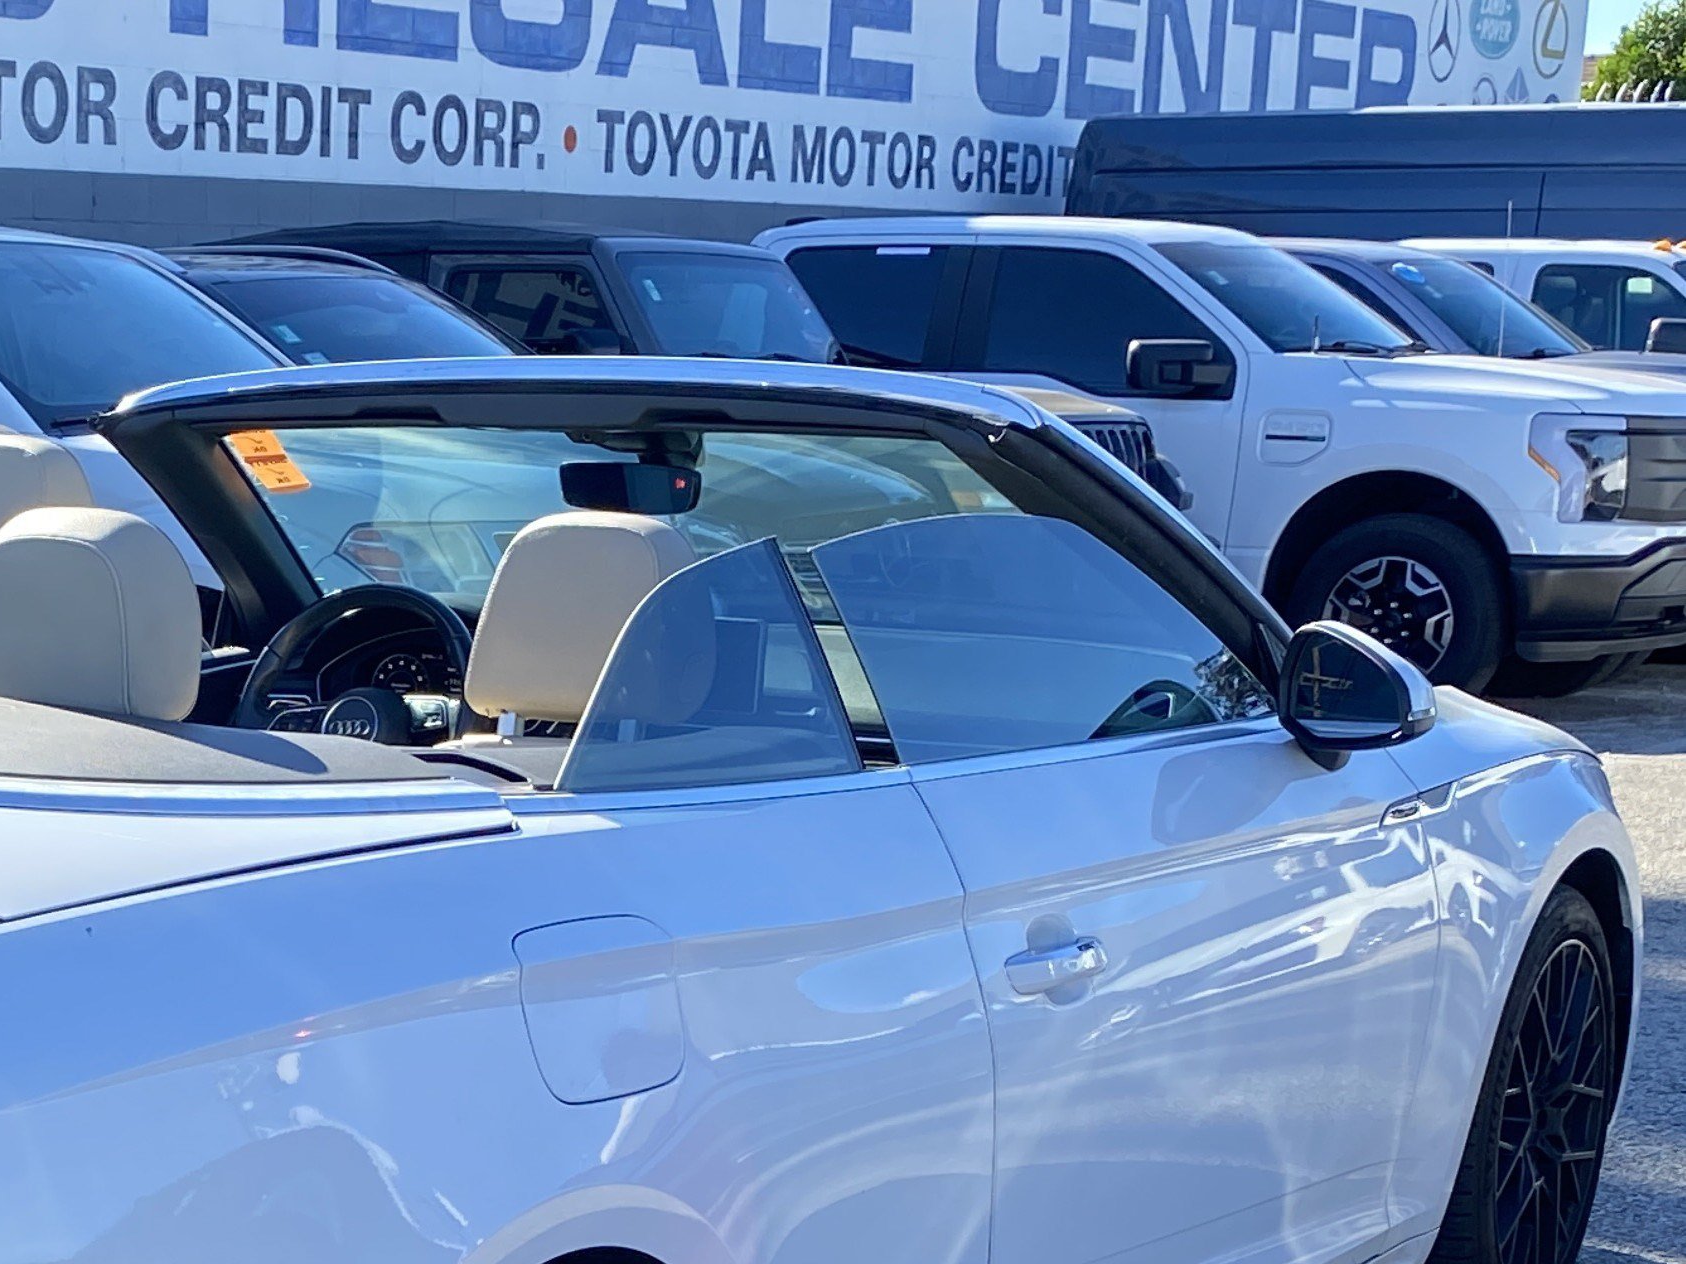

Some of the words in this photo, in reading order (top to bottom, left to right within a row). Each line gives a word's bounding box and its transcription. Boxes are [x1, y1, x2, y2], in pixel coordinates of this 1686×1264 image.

[974, 0, 1418, 119] CENTER
[145, 69, 372, 161] CREDIT
[390, 89, 545, 171] CORP.
[596, 108, 776, 183] TOYOTA
[790, 124, 936, 191] MOTOR
[951, 135, 1076, 198] CREDIT
